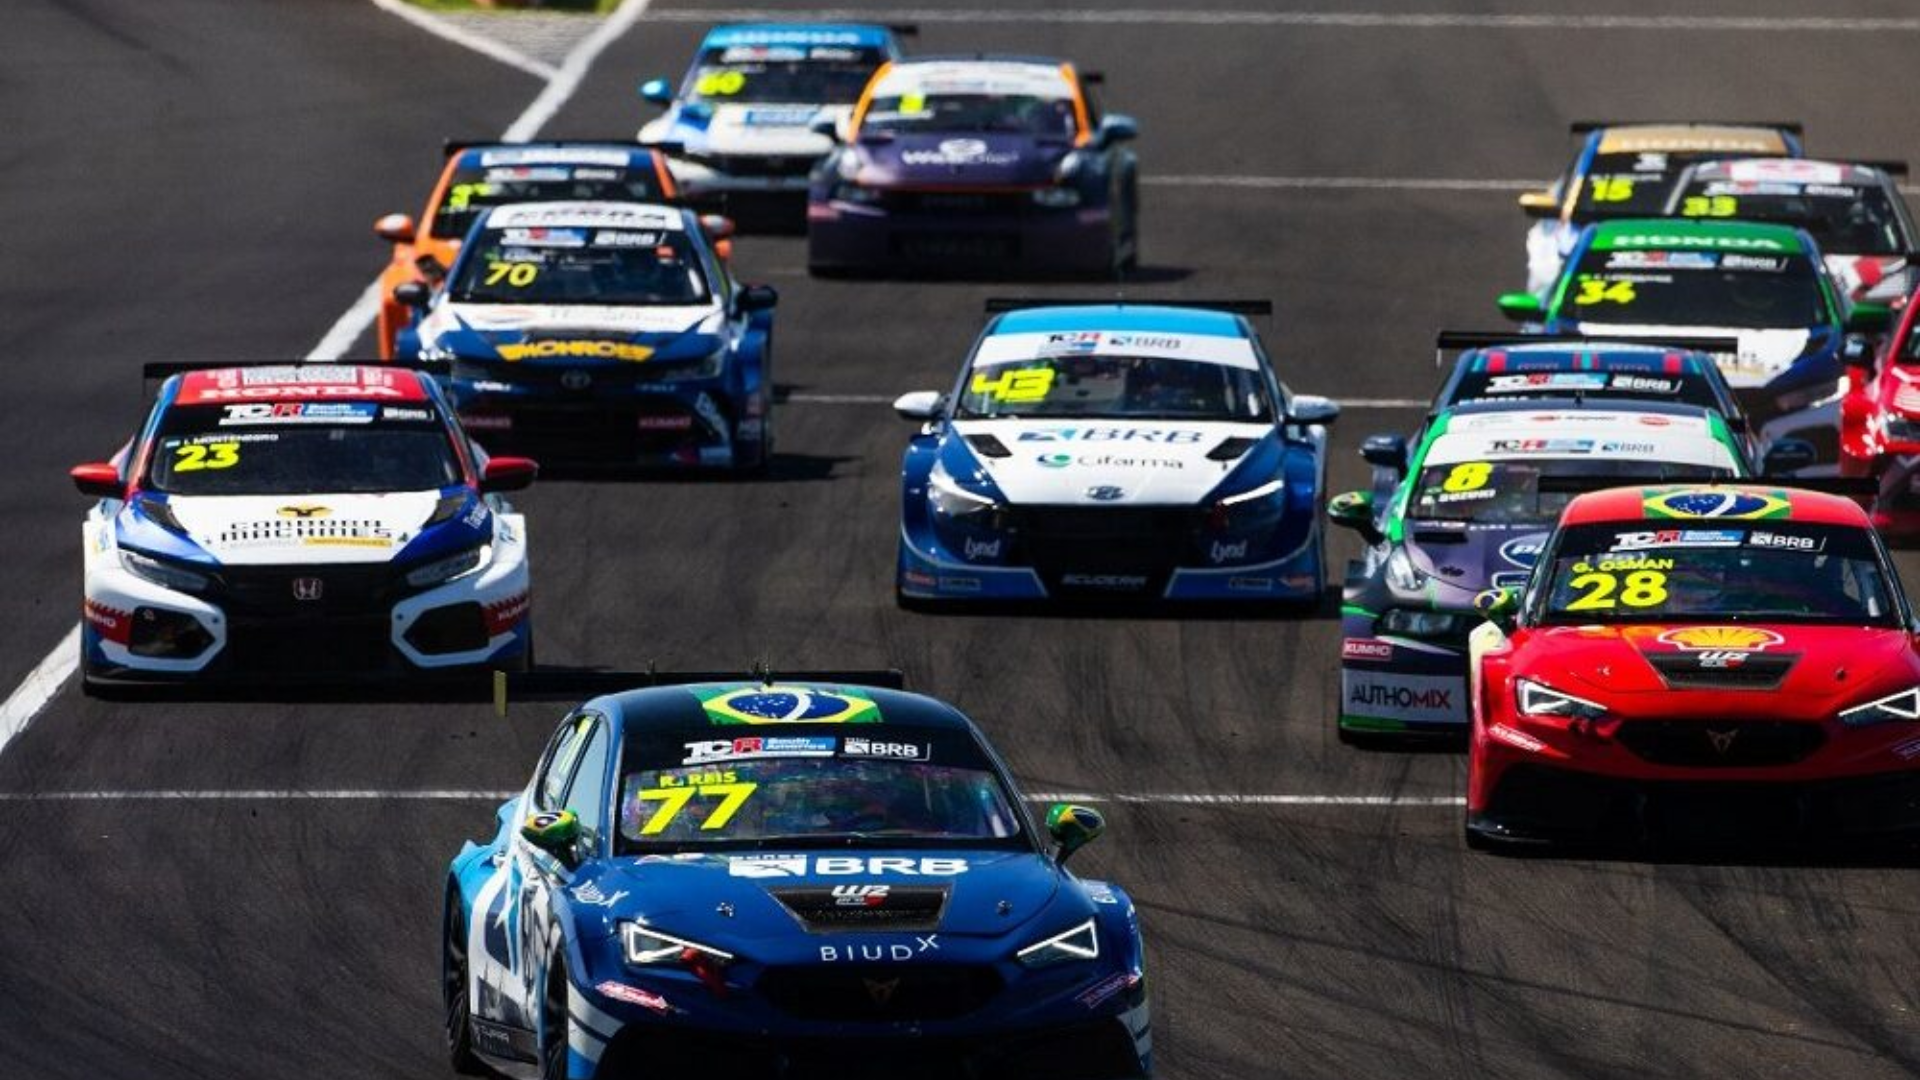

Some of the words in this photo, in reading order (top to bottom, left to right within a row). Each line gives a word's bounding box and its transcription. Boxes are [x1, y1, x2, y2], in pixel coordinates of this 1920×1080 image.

[1612, 235, 1783, 249] HONDA
[484, 262, 538, 288] 70
[1574, 280, 1637, 304] 34
[200, 385, 404, 400] HONDA
[970, 368, 1055, 402] 43
[1080, 428, 1205, 444] BRB
[173, 443, 241, 473] 23
[1443, 461, 1494, 492] 8
[1772, 535, 1815, 549] BRB
[1598, 558, 1674, 571] OSMAN
[1565, 569, 1669, 611] 28
[1343, 641, 1391, 657] KUMHO
[1350, 683, 1451, 710] AUTHOMIX
[682, 737, 763, 758] TCR
[870, 742, 920, 758] BRB
[637, 783, 758, 835] 77
[815, 856, 969, 876] BRB
